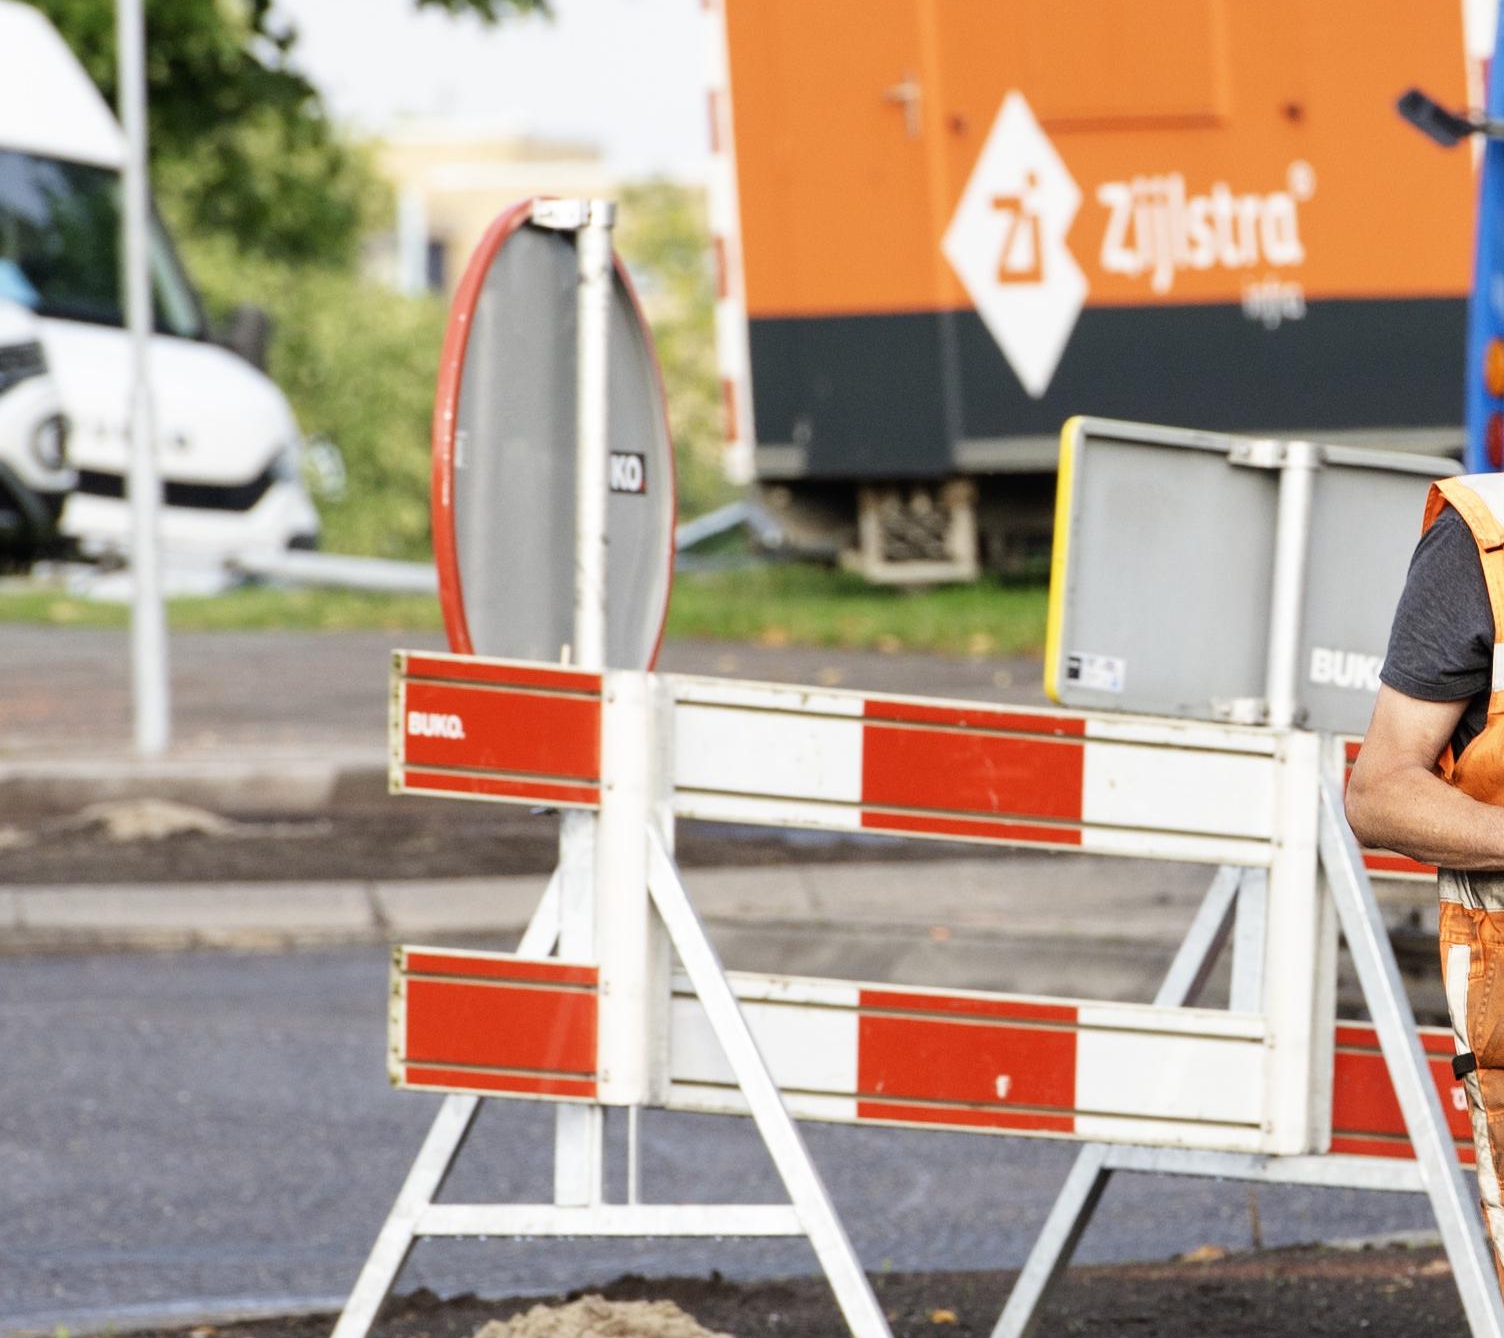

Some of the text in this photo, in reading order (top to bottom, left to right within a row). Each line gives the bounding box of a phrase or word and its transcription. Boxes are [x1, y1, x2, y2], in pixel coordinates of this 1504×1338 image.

[1095, 171, 1307, 297] Zijlstra
[610, 455, 645, 492] KO.
[1310, 647, 1383, 692] BUK
[408, 710, 467, 739] BUKO.
